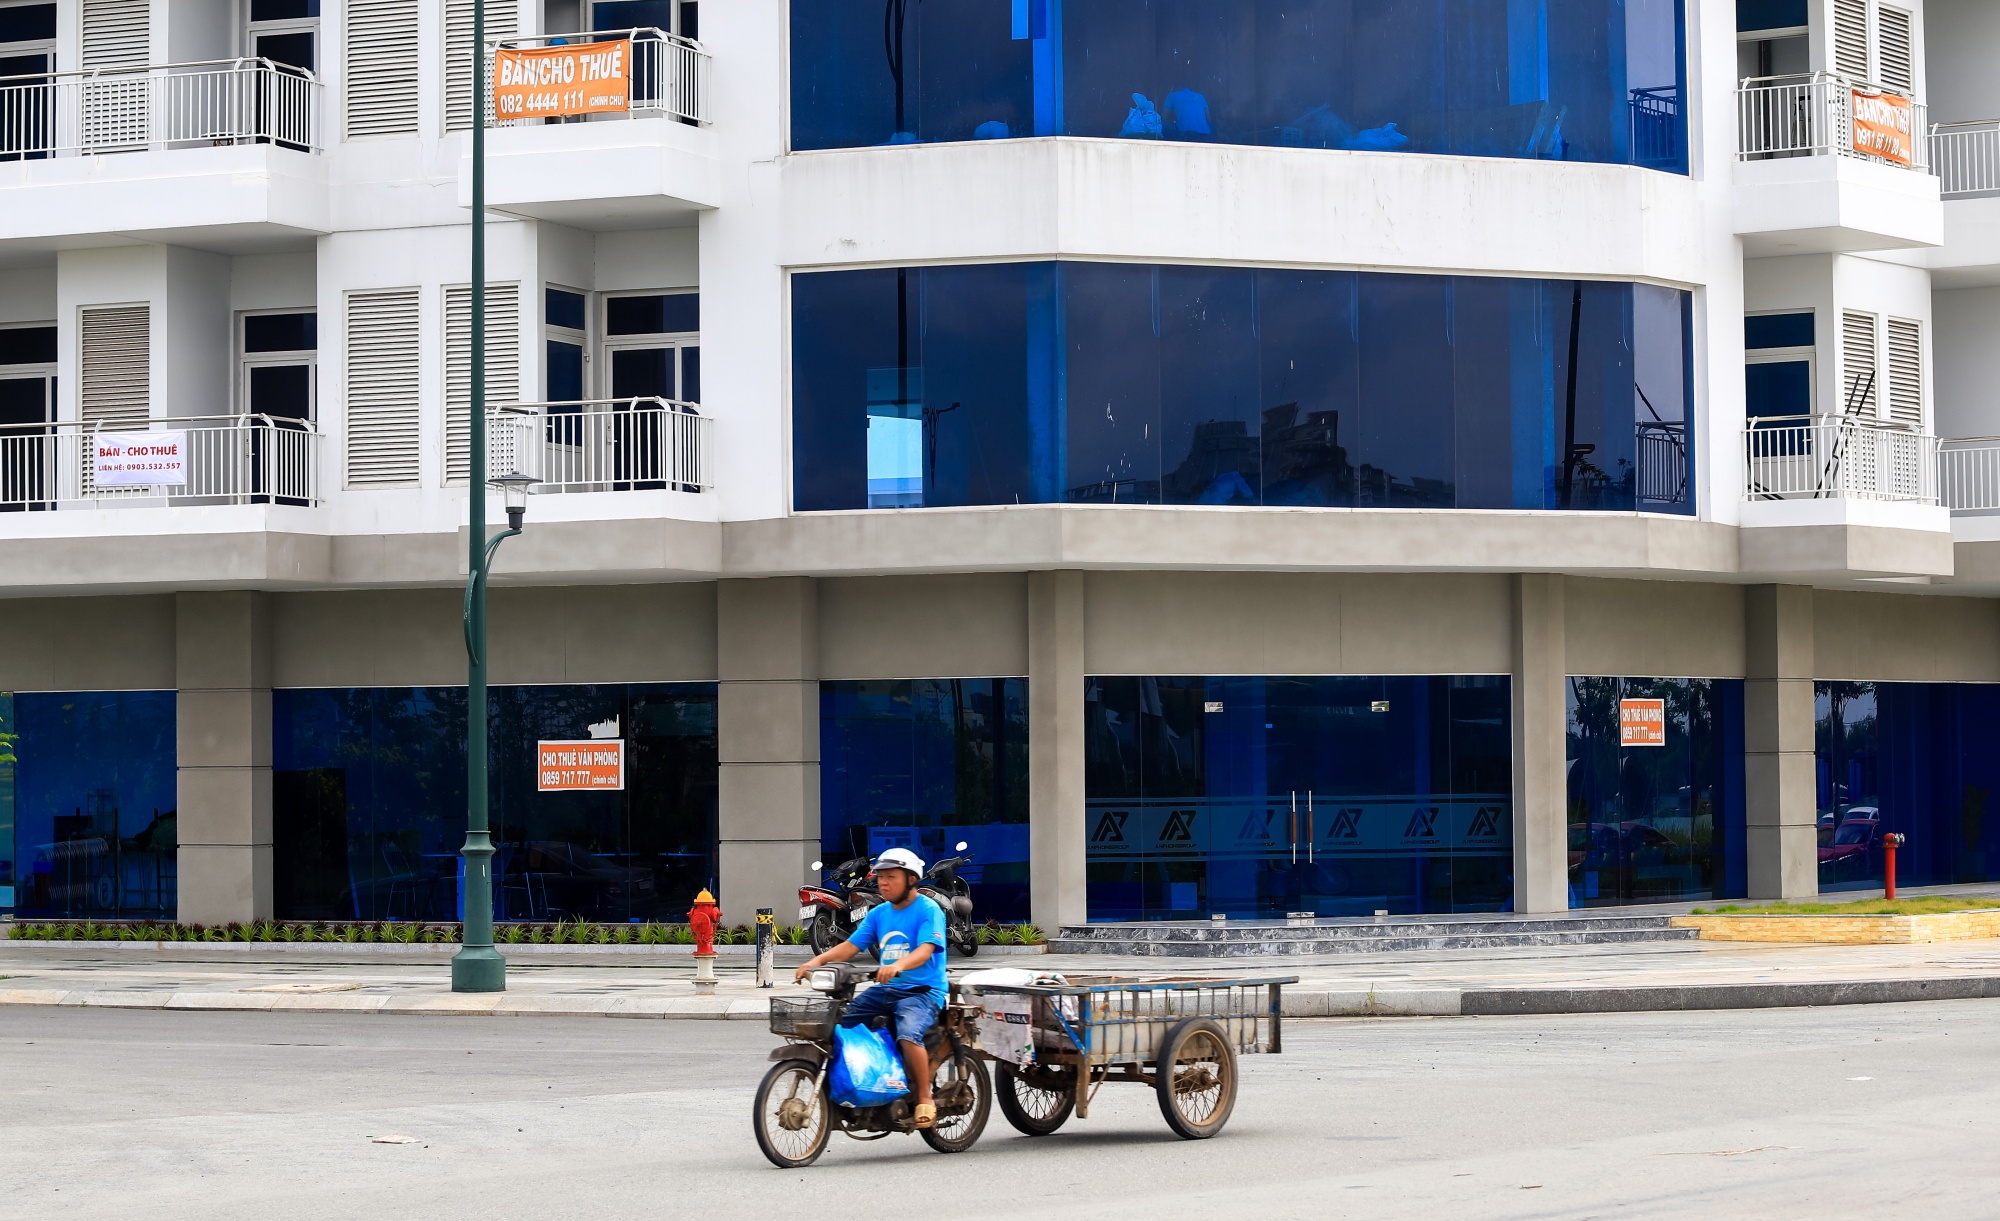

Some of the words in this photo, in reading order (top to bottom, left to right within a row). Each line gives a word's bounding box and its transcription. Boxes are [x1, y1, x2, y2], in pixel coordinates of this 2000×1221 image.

[500, 53, 575, 88] BÁN/CHO
[580, 44, 623, 82] THUÊ
[501, 94, 523, 114] 082
[526, 92, 559, 112] 4444
[563, 90, 584, 109] 111
[588, 94, 609, 109] (CHÍNH
[99, 446, 120, 457] BÁN
[127, 446, 148, 456] CHO
[150, 444, 178, 456] THUÊ
[98, 463, 113, 472] LIÊN
[126, 462, 181, 470] 0903.532.557
[542, 752, 557, 767] CHO
[558, 748, 577, 767] THUÊ
[578, 748, 593, 766] VĂN
[594, 747, 618, 766] PHÒNG
[542, 771, 560, 785] 0859
[562, 771, 575, 785] 717
[576, 770, 590, 785] 777
